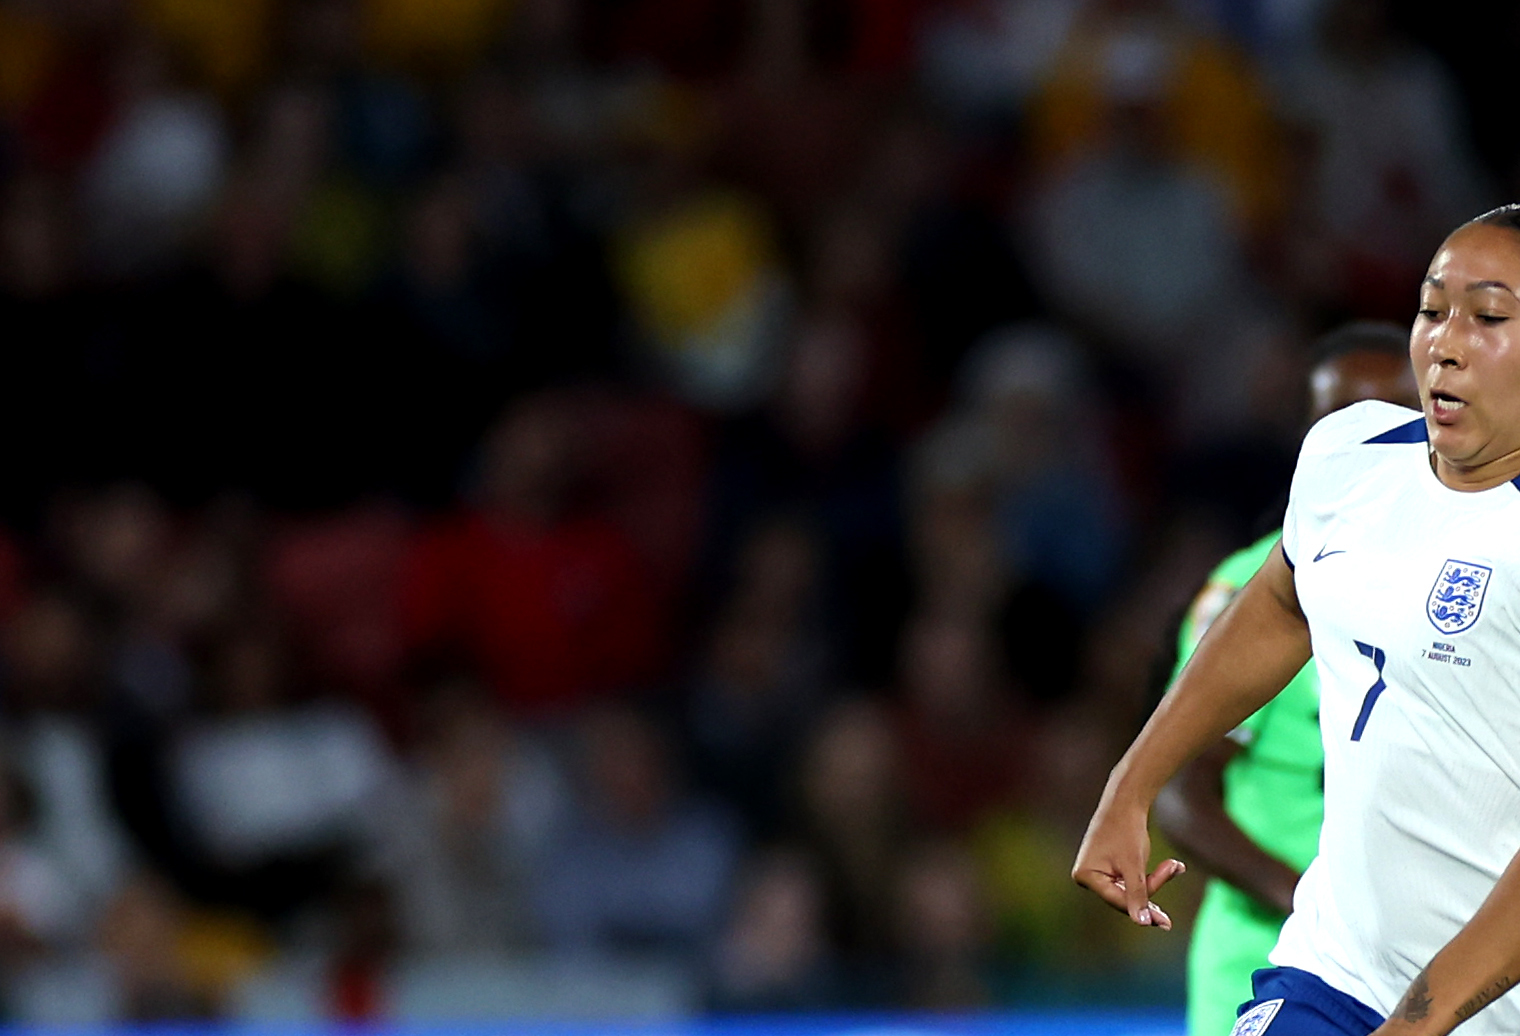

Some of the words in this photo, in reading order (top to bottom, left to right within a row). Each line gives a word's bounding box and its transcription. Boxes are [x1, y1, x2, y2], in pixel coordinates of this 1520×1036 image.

[1432, 641, 1455, 653] NIGERIA
[1421, 648, 1427, 657] 7
[1428, 652, 1451, 664] AUGUST
[1452, 656, 1471, 667] 2023
[1350, 639, 1387, 742] 7
